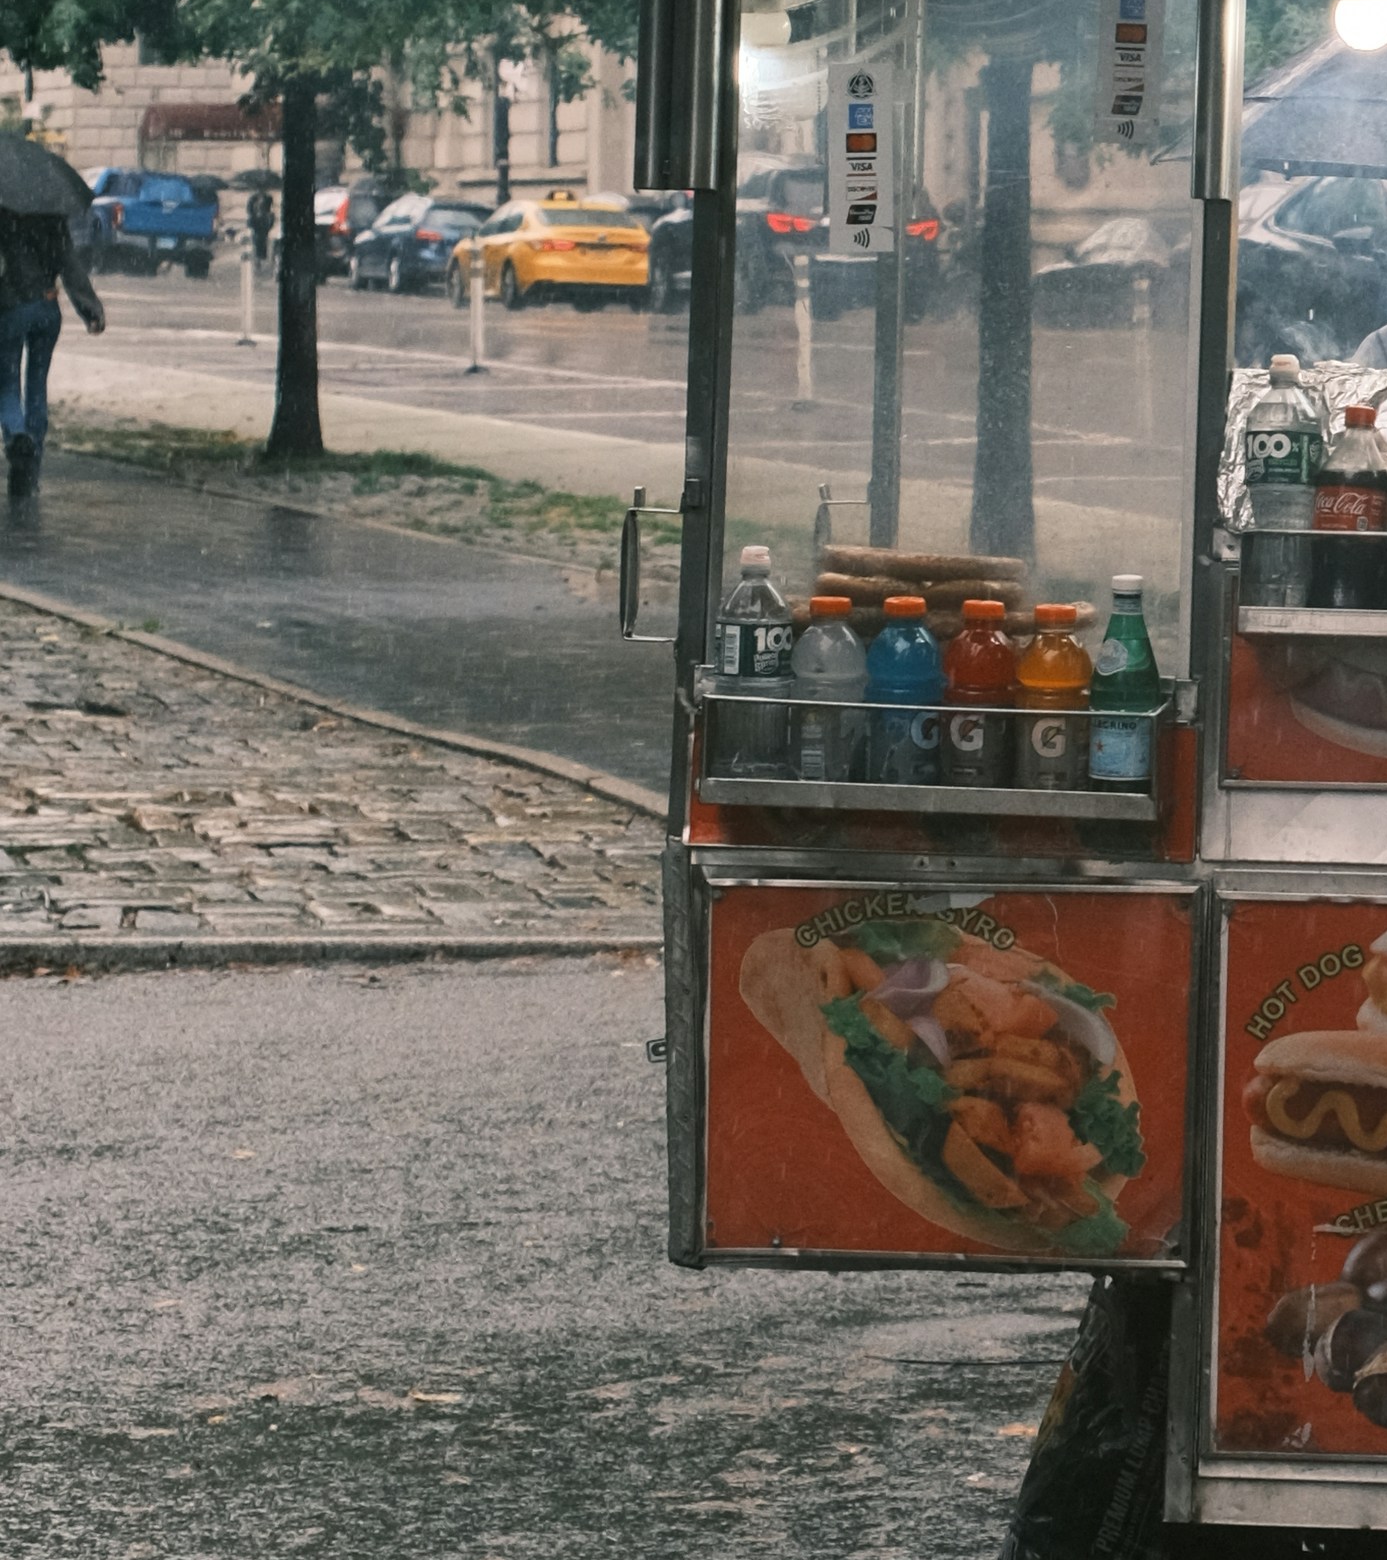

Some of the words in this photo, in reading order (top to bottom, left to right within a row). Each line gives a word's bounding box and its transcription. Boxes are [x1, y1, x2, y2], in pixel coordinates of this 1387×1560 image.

[1120, 53, 1142, 62] VISA
[849, 162, 873, 172] VISA
[949, 714, 984, 752] G
[1030, 716, 1067, 758] G
[937, 906, 1015, 951] GYRO
[1246, 981, 1300, 1042] HOT
[1300, 942, 1364, 994] DOG
[1095, 1469, 1139, 1553] PREMIUM
